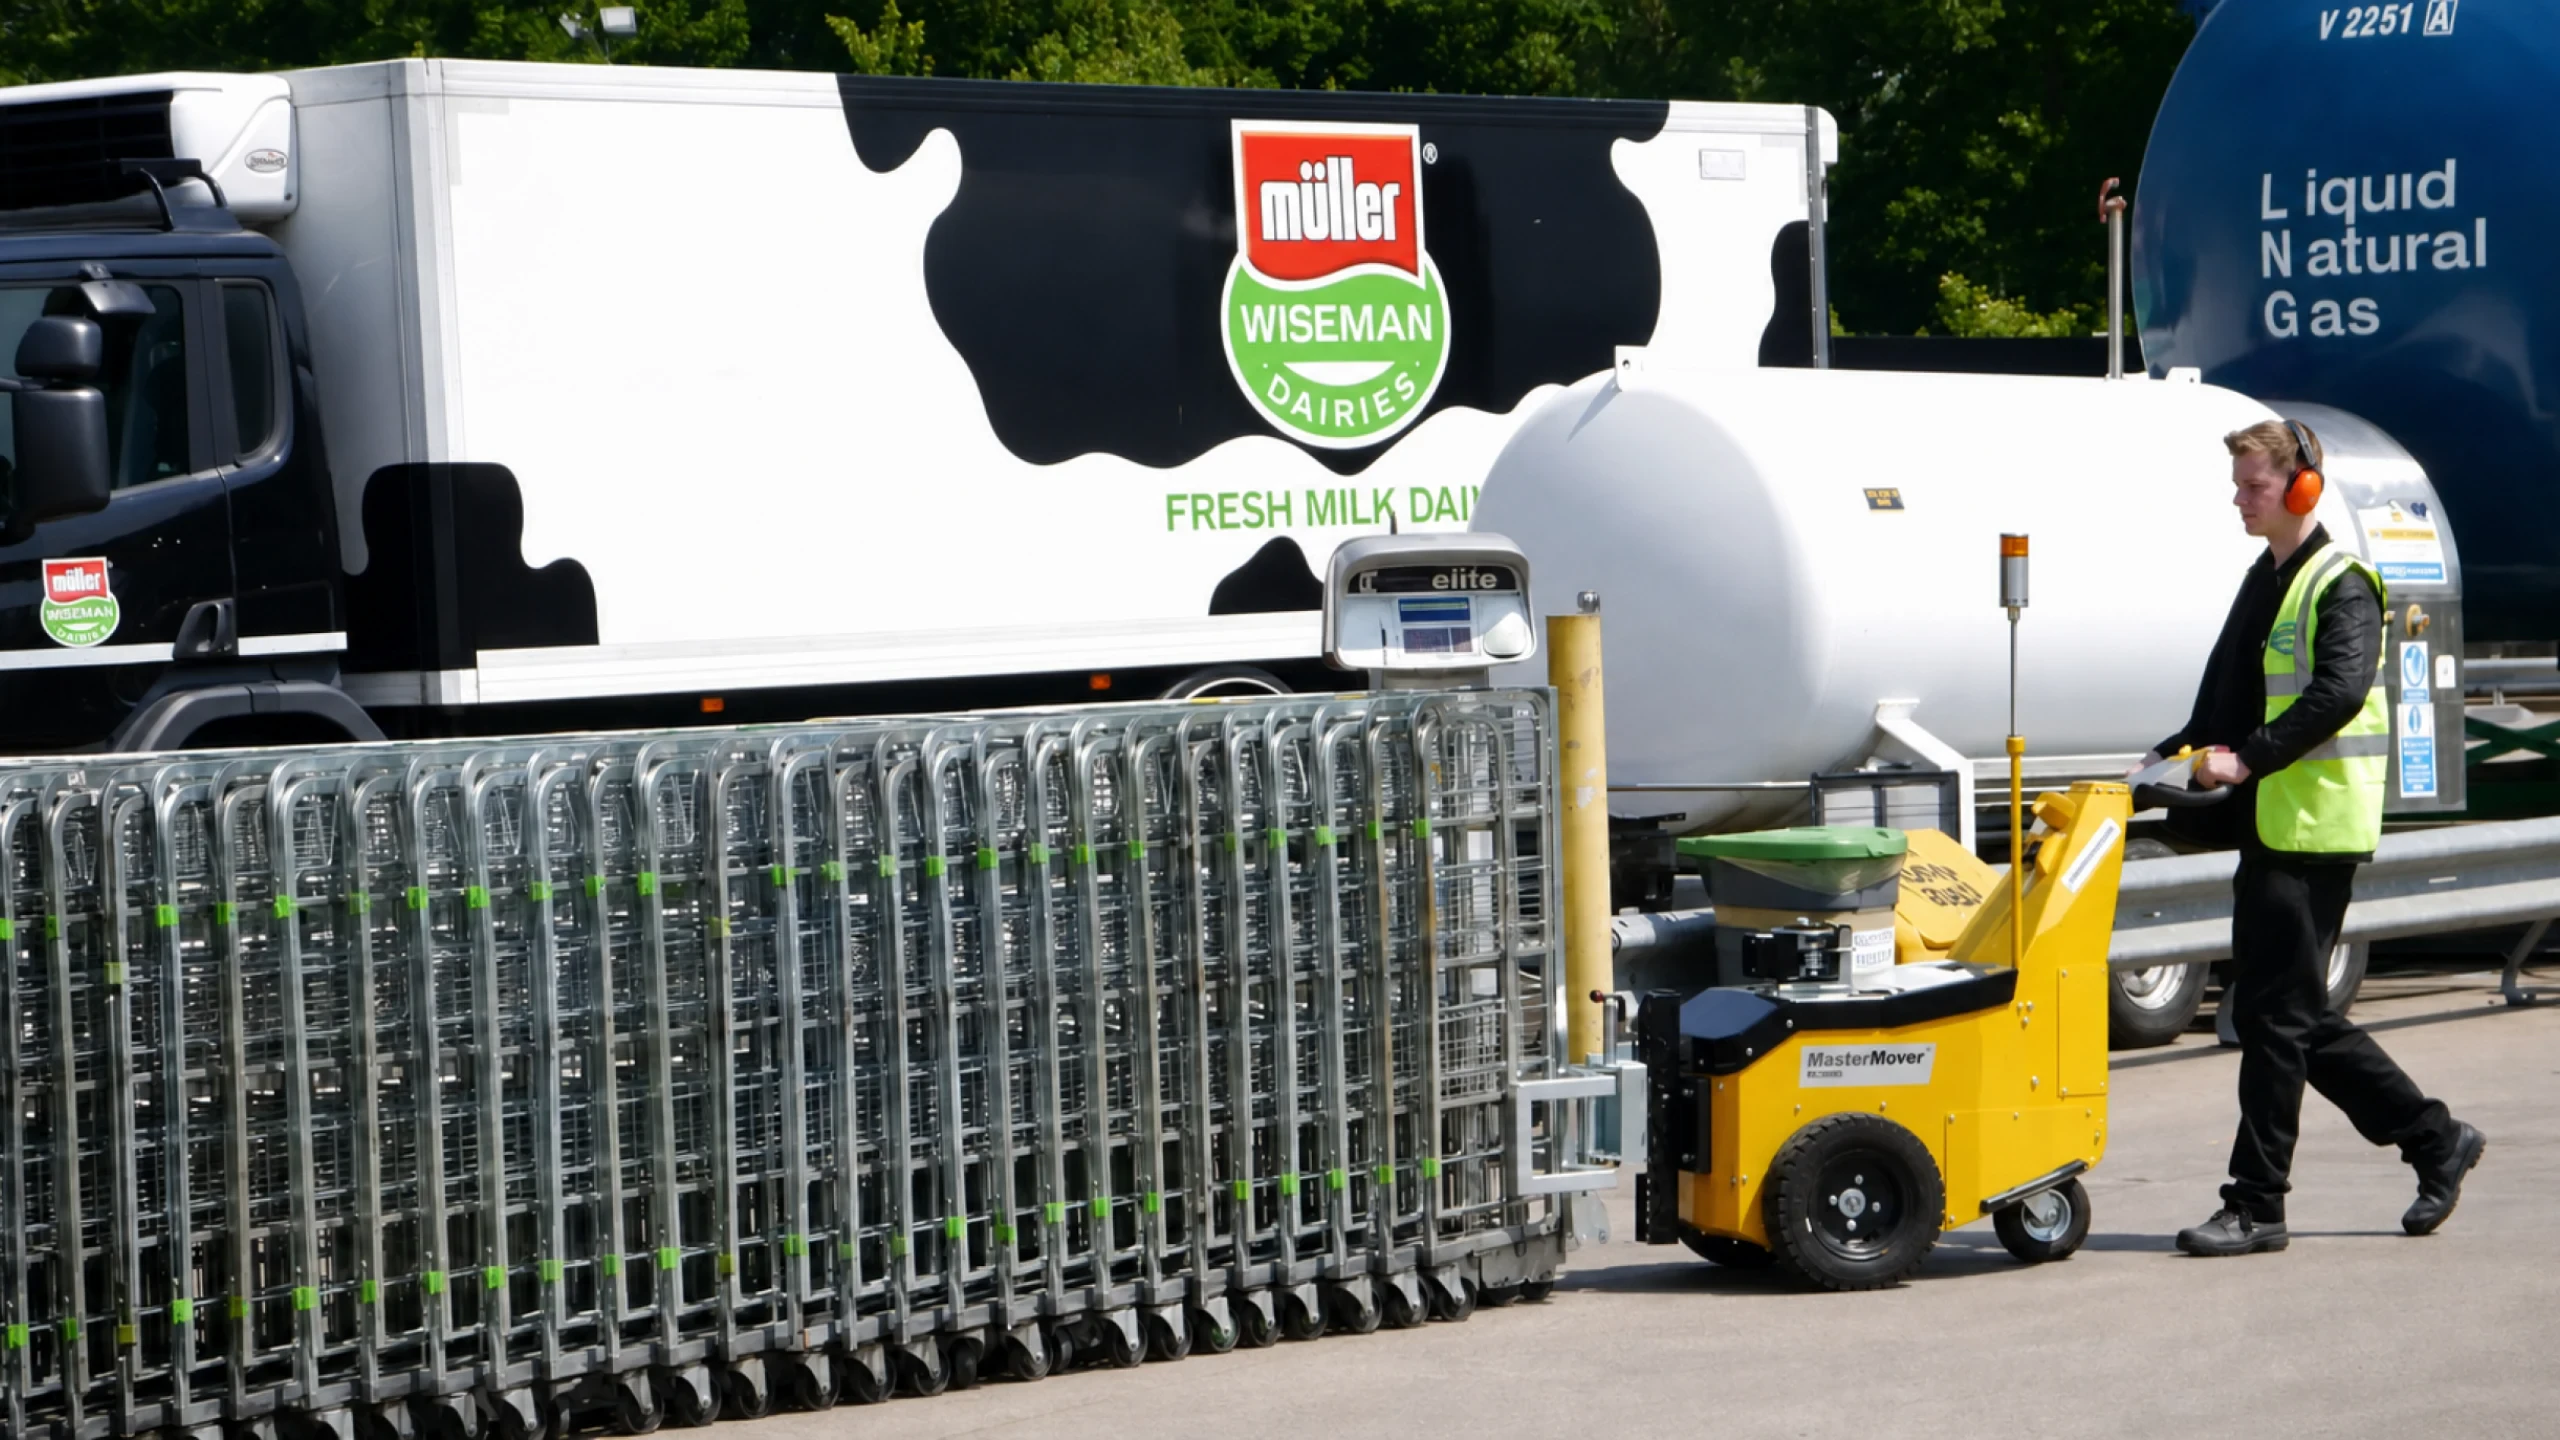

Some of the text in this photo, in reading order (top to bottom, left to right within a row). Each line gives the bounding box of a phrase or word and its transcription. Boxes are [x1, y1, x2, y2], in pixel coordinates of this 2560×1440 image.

[2320, 0, 2450, 40] V 2251 A
[1260, 156, 1400, 241] müller
[1240, 304, 1433, 343] WISEMAN
[1267, 371, 1416, 428] DAIRIES
[1166, 490, 1292, 531] FRESH
[1306, 487, 1395, 527] MILK
[52, 566, 101, 592] müller
[1807, 1050, 1925, 1068] MasterMover
